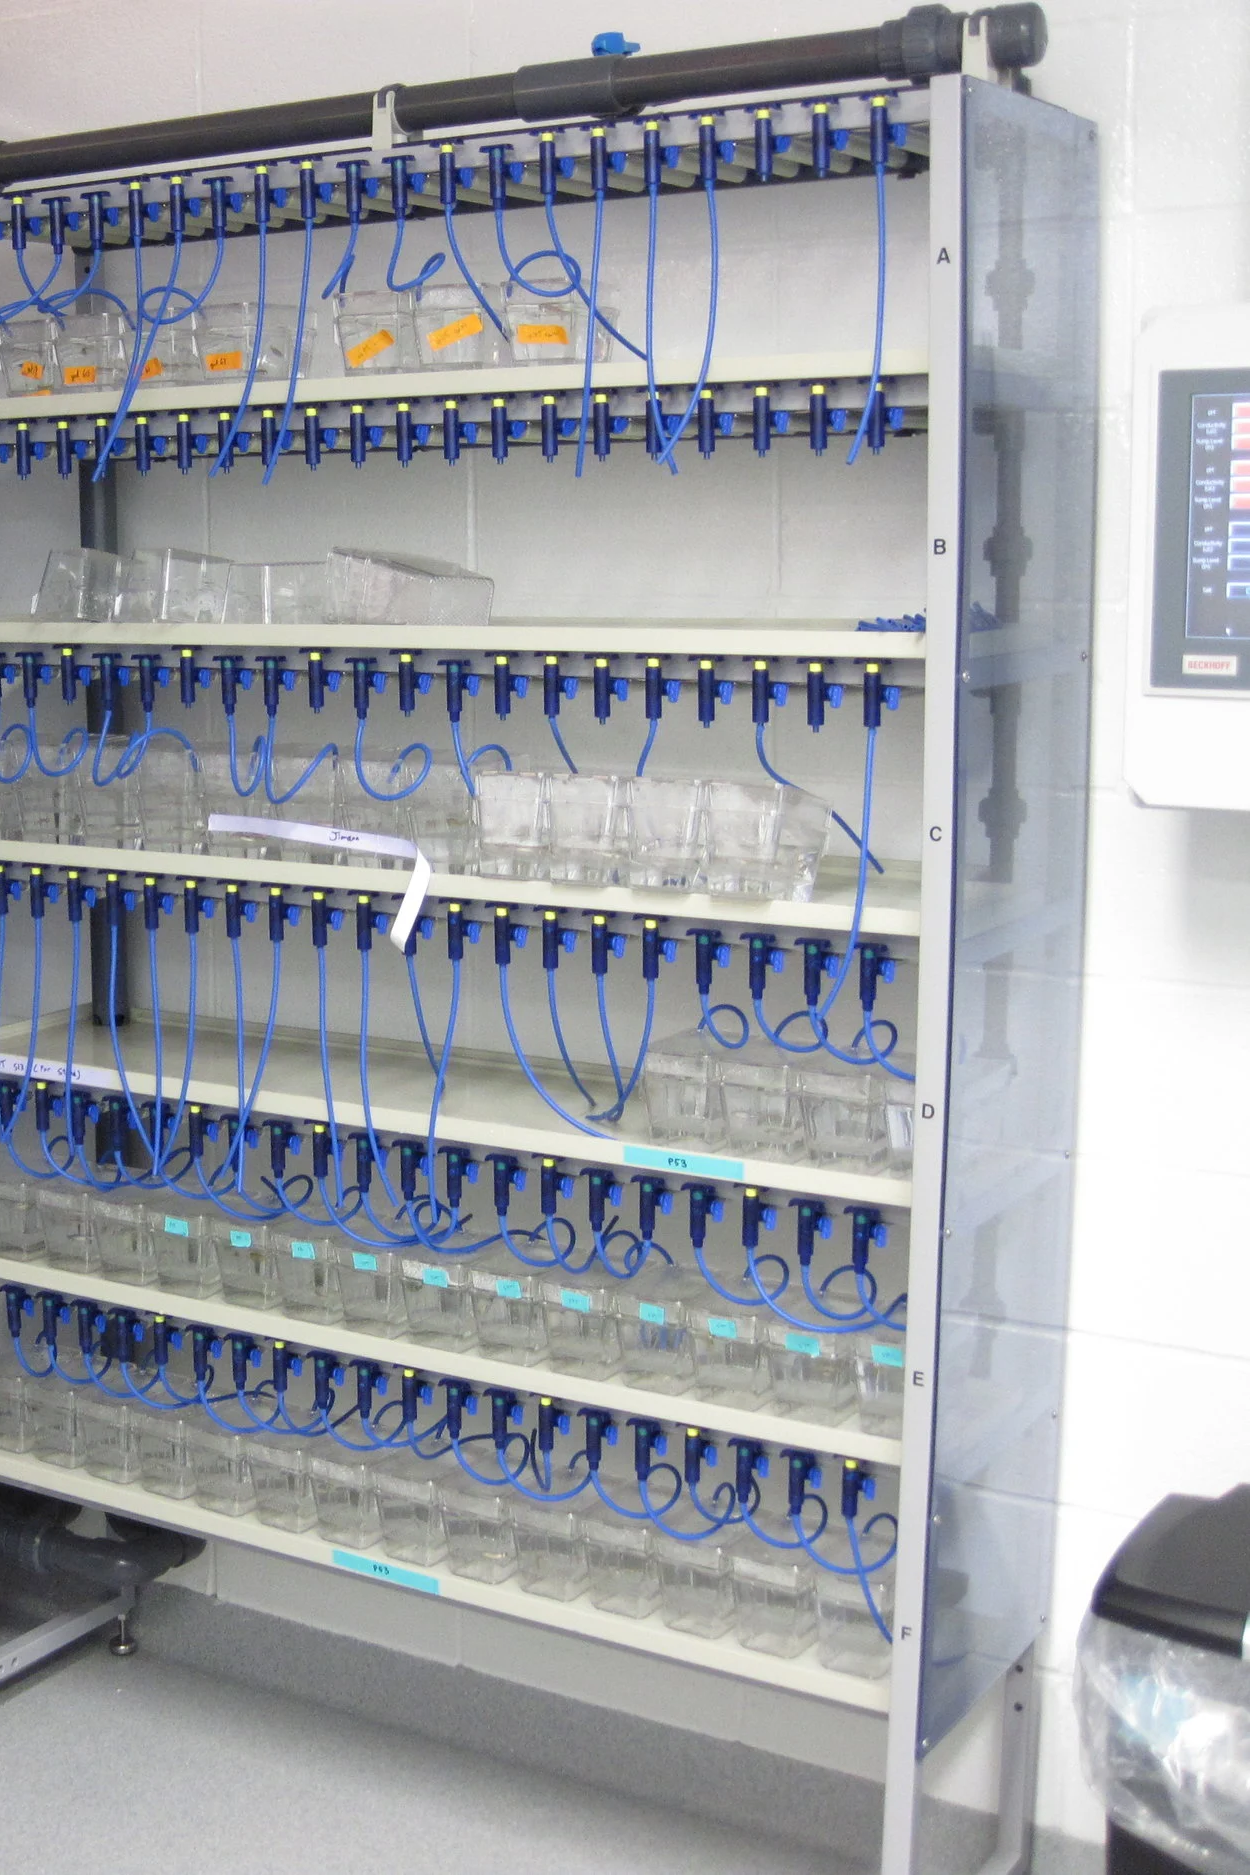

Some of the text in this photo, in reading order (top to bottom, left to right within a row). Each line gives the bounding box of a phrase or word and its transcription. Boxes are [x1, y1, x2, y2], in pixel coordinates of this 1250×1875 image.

[937, 247, 950, 265] A
[934, 539, 947, 555] B
[1187, 660, 1231, 670] BECKHOFF
[929, 826, 942, 842] C
[921, 1103, 936, 1120] D
[912, 1371, 925, 1388] E
[900, 1626, 912, 1641] F
